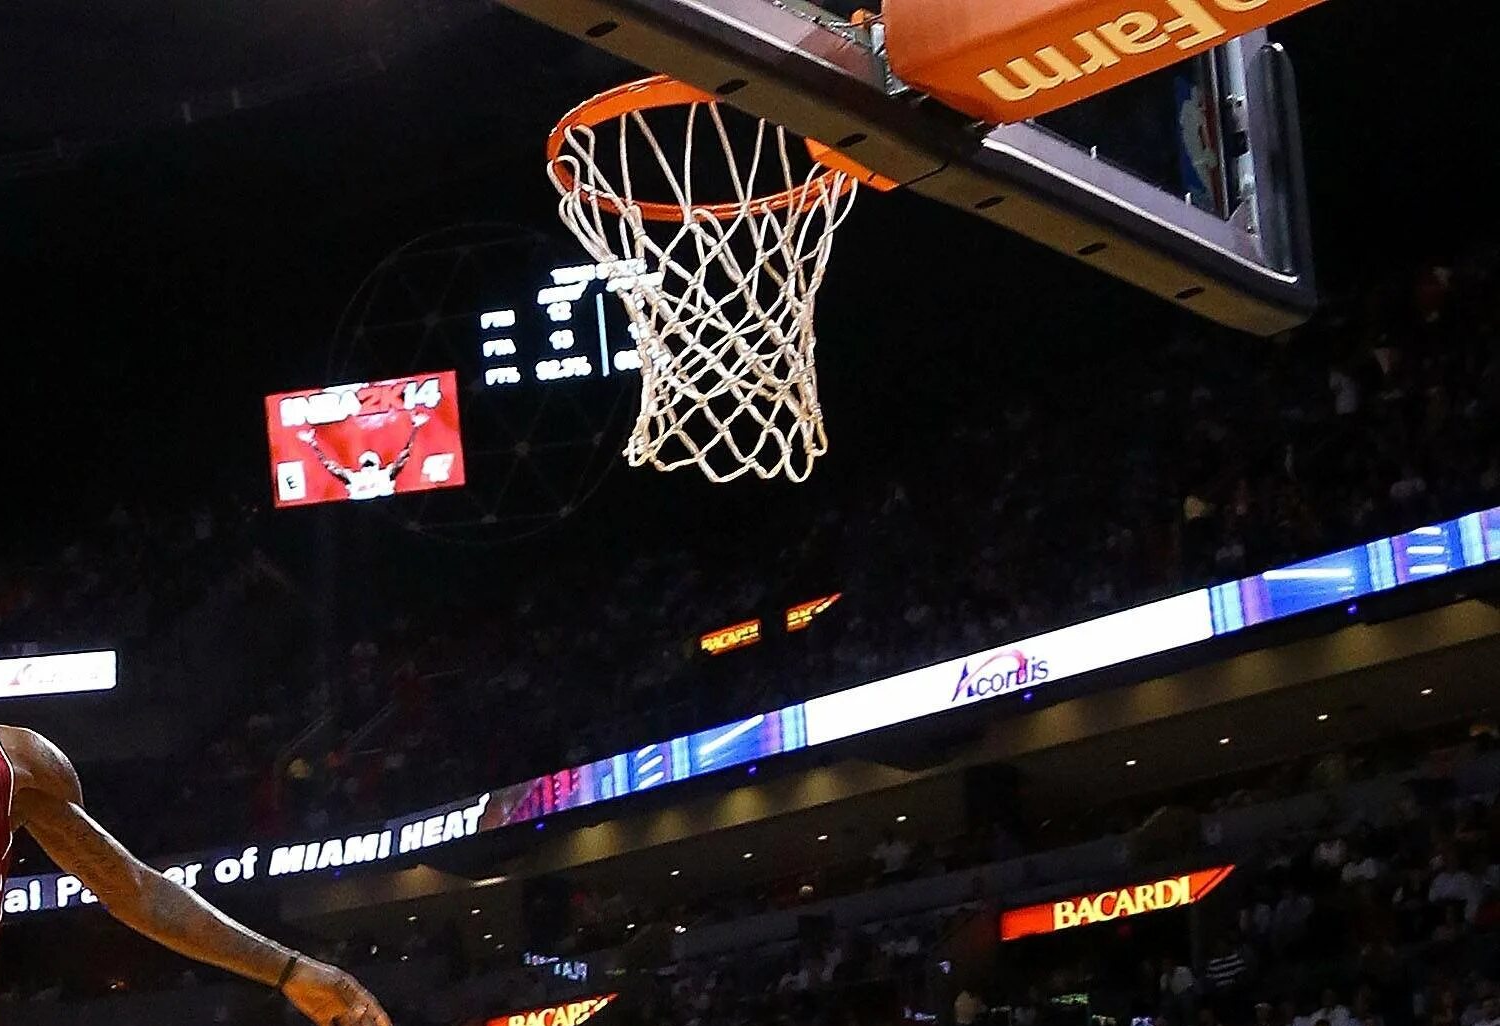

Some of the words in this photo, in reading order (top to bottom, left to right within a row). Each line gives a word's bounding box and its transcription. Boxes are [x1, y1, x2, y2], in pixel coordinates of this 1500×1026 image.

[977, 0, 1227, 101] Farm
[215, 847, 258, 885] of
[269, 831, 392, 876] MIAMI
[399, 793, 490, 853] HEAT
[1053, 875, 1193, 931] BACARDI
